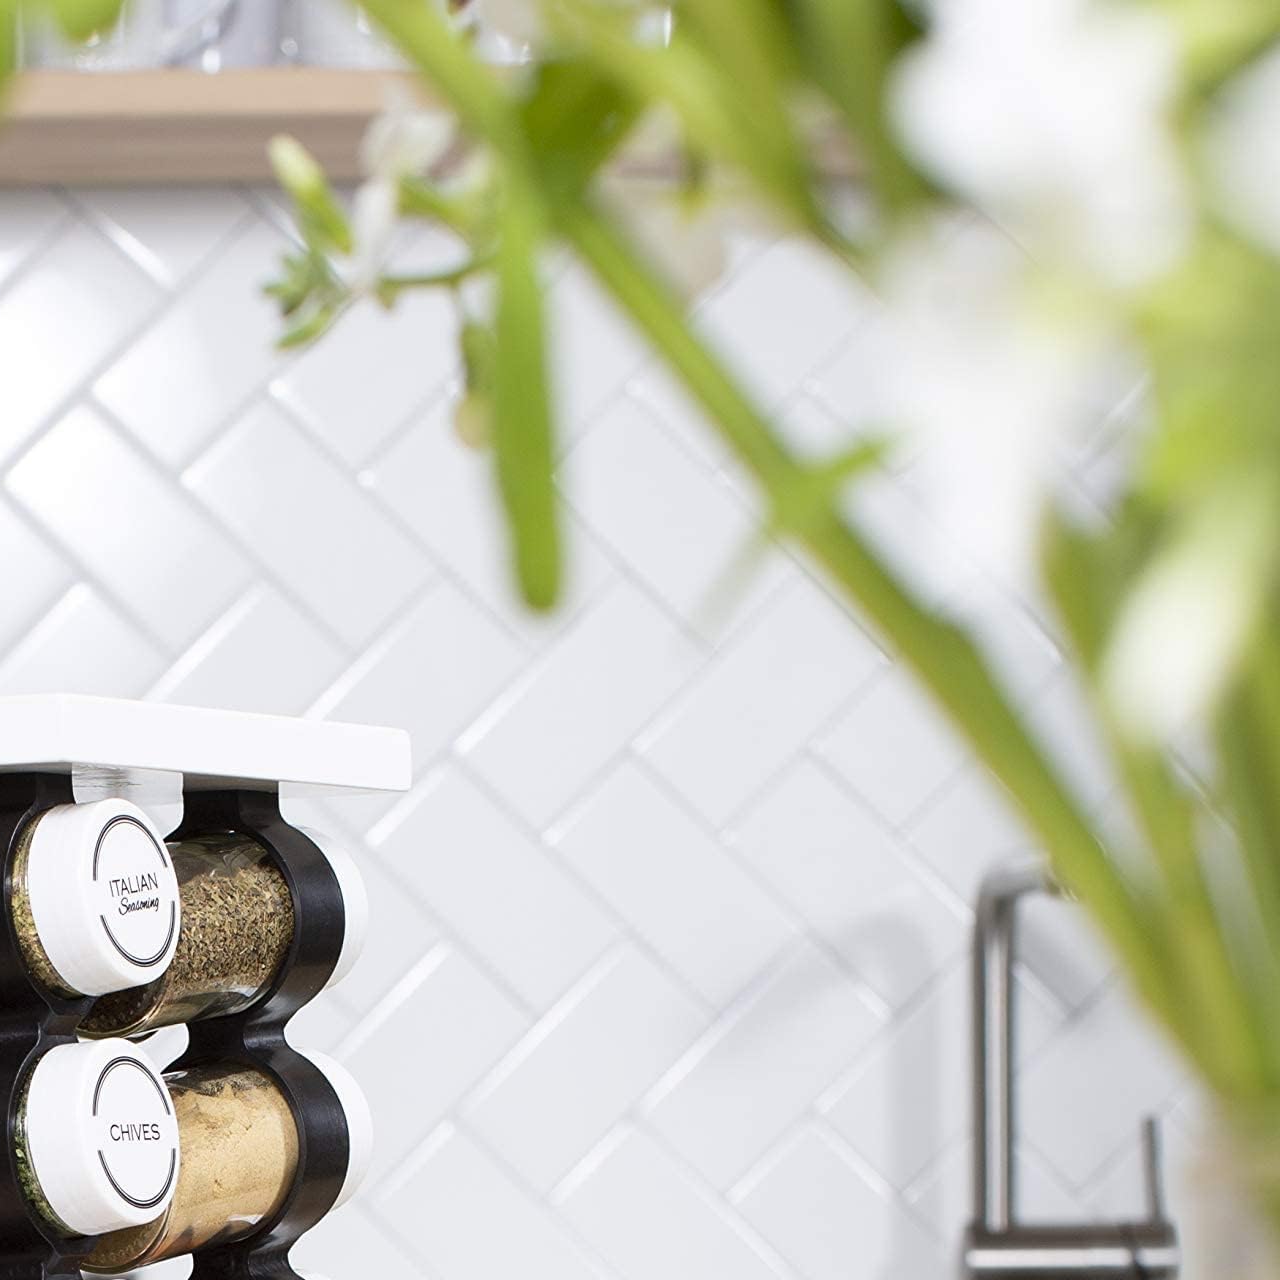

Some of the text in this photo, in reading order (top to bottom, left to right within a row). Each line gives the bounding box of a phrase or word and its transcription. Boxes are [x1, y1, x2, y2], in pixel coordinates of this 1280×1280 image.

[109, 872, 159, 898] ITALIAN
[118, 897, 160, 916] Seasoning
[109, 1123, 161, 1142] CHIVES
